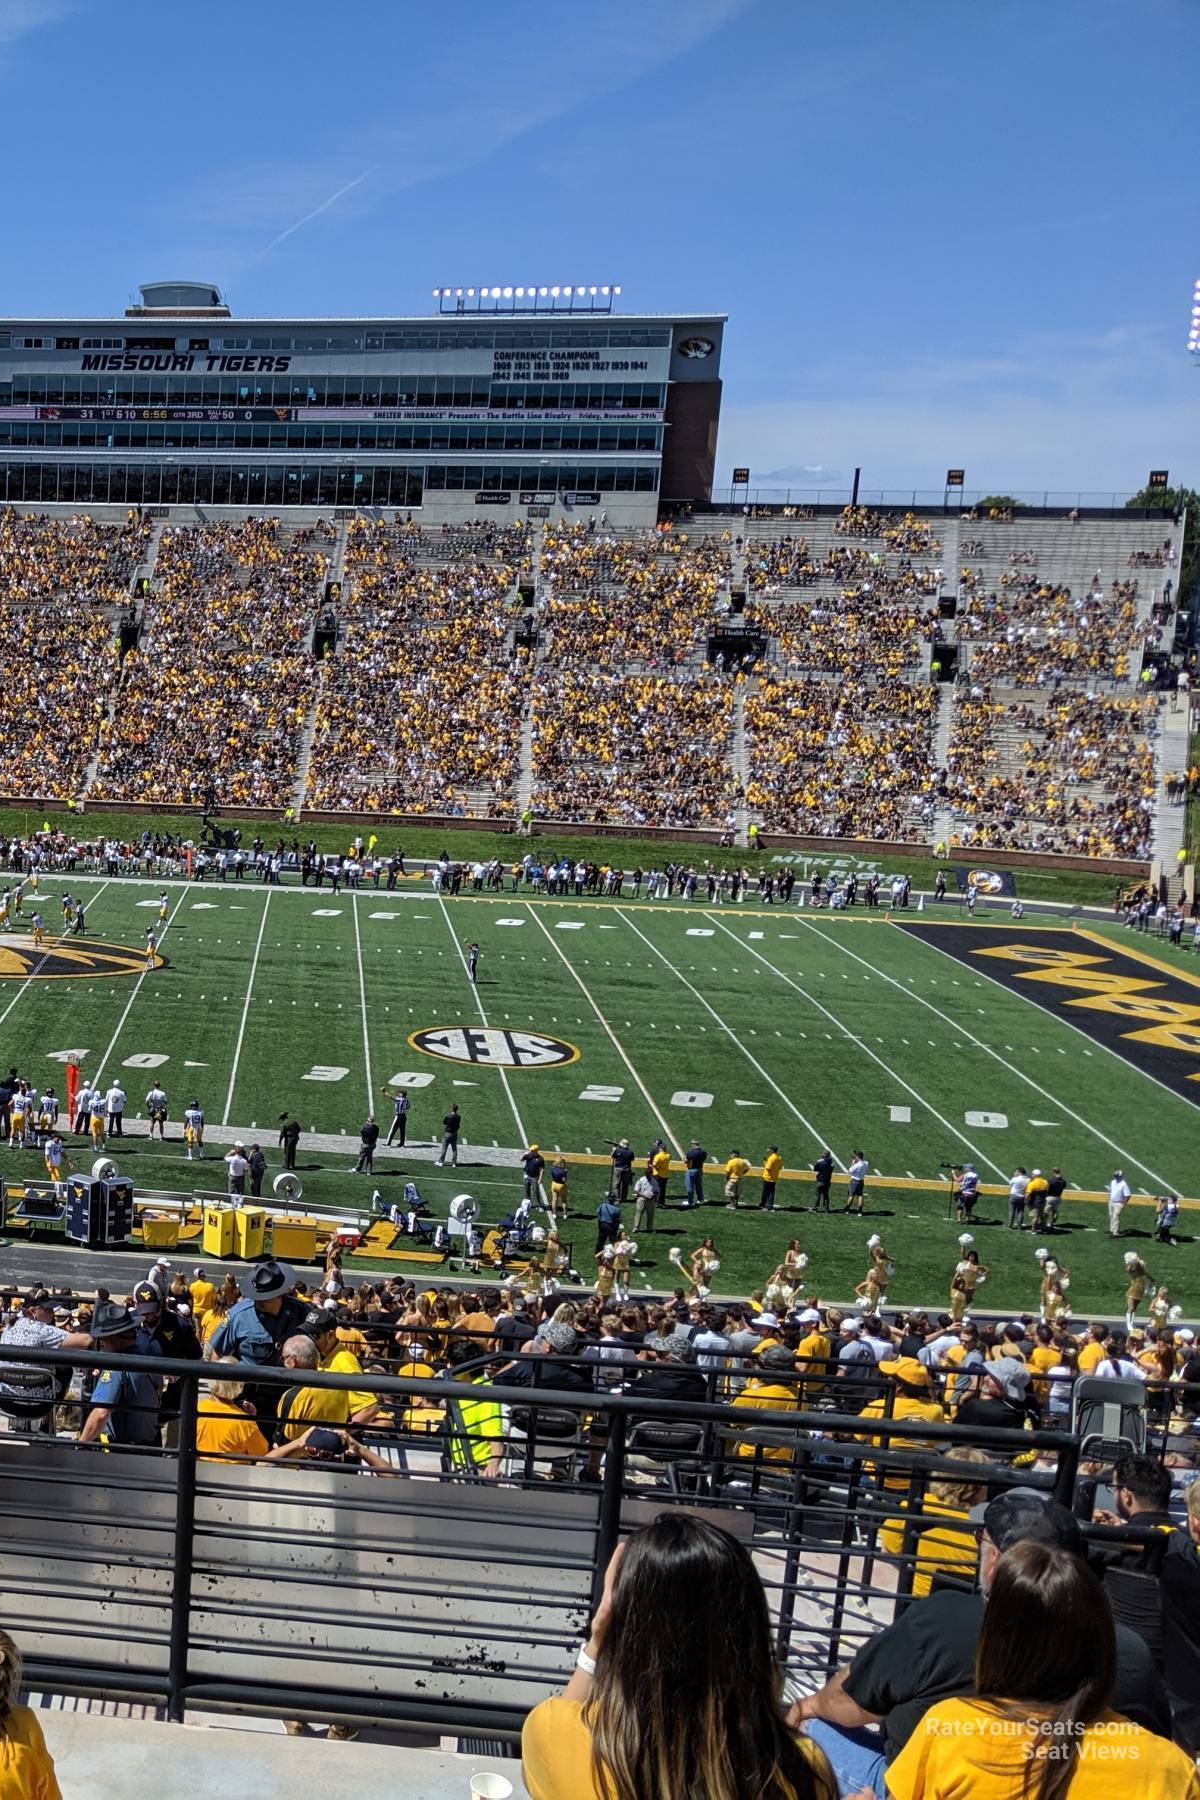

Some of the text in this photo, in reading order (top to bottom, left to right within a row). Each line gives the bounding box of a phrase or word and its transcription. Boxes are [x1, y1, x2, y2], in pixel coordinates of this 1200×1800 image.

[493, 351, 600, 360] CONFERENCE CHAMPIONS
[80, 355, 292, 372] MISSOURI TIGERS
[630, 361, 648, 371] 1941
[80, 409, 93, 419] 31
[124, 409, 136, 419] 10
[142, 410, 168, 419] 6:56
[186, 411, 204, 419] 3RD
[222, 410, 234, 420] 50
[373, 411, 401, 420] SHELTER
[770, 854, 855, 867] MAKE
[414, 1026, 575, 1067] SEC
[301, 1065, 437, 1088] 30
[577, 1085, 716, 1109] 20
[886, 1105, 1010, 1129] 10
[3, 1372, 23, 1380] EVENT
